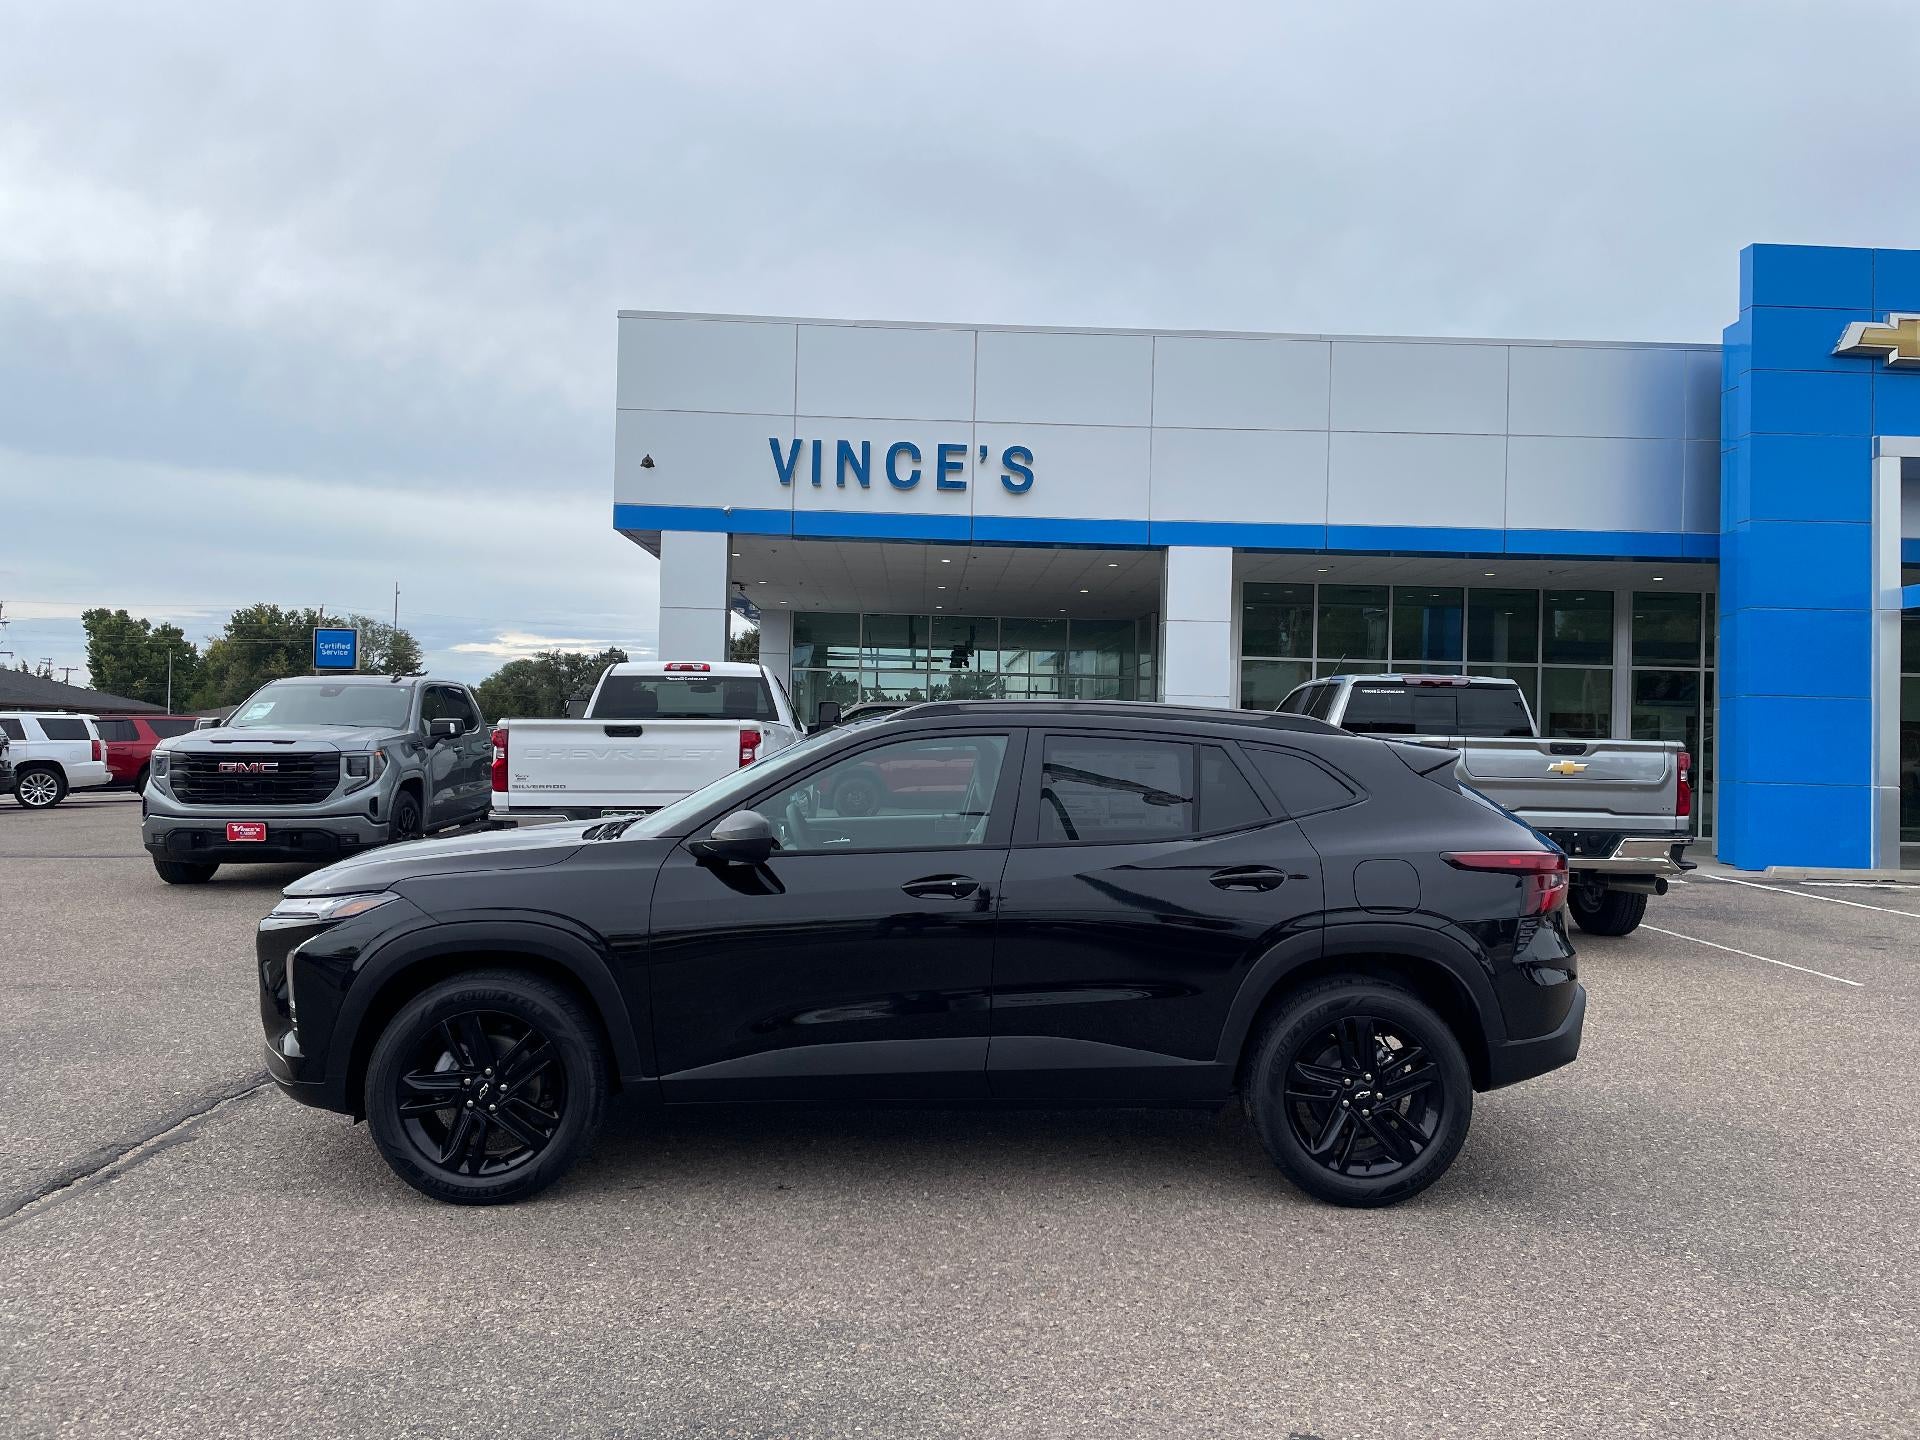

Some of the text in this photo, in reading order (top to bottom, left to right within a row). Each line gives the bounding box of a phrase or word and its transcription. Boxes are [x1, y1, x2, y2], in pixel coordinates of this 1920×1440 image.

[768, 437, 1035, 495] VINCE'S
[319, 642, 351, 650] Certified
[523, 748, 724, 761] CHEVROLET
[218, 762, 279, 773] GMC
